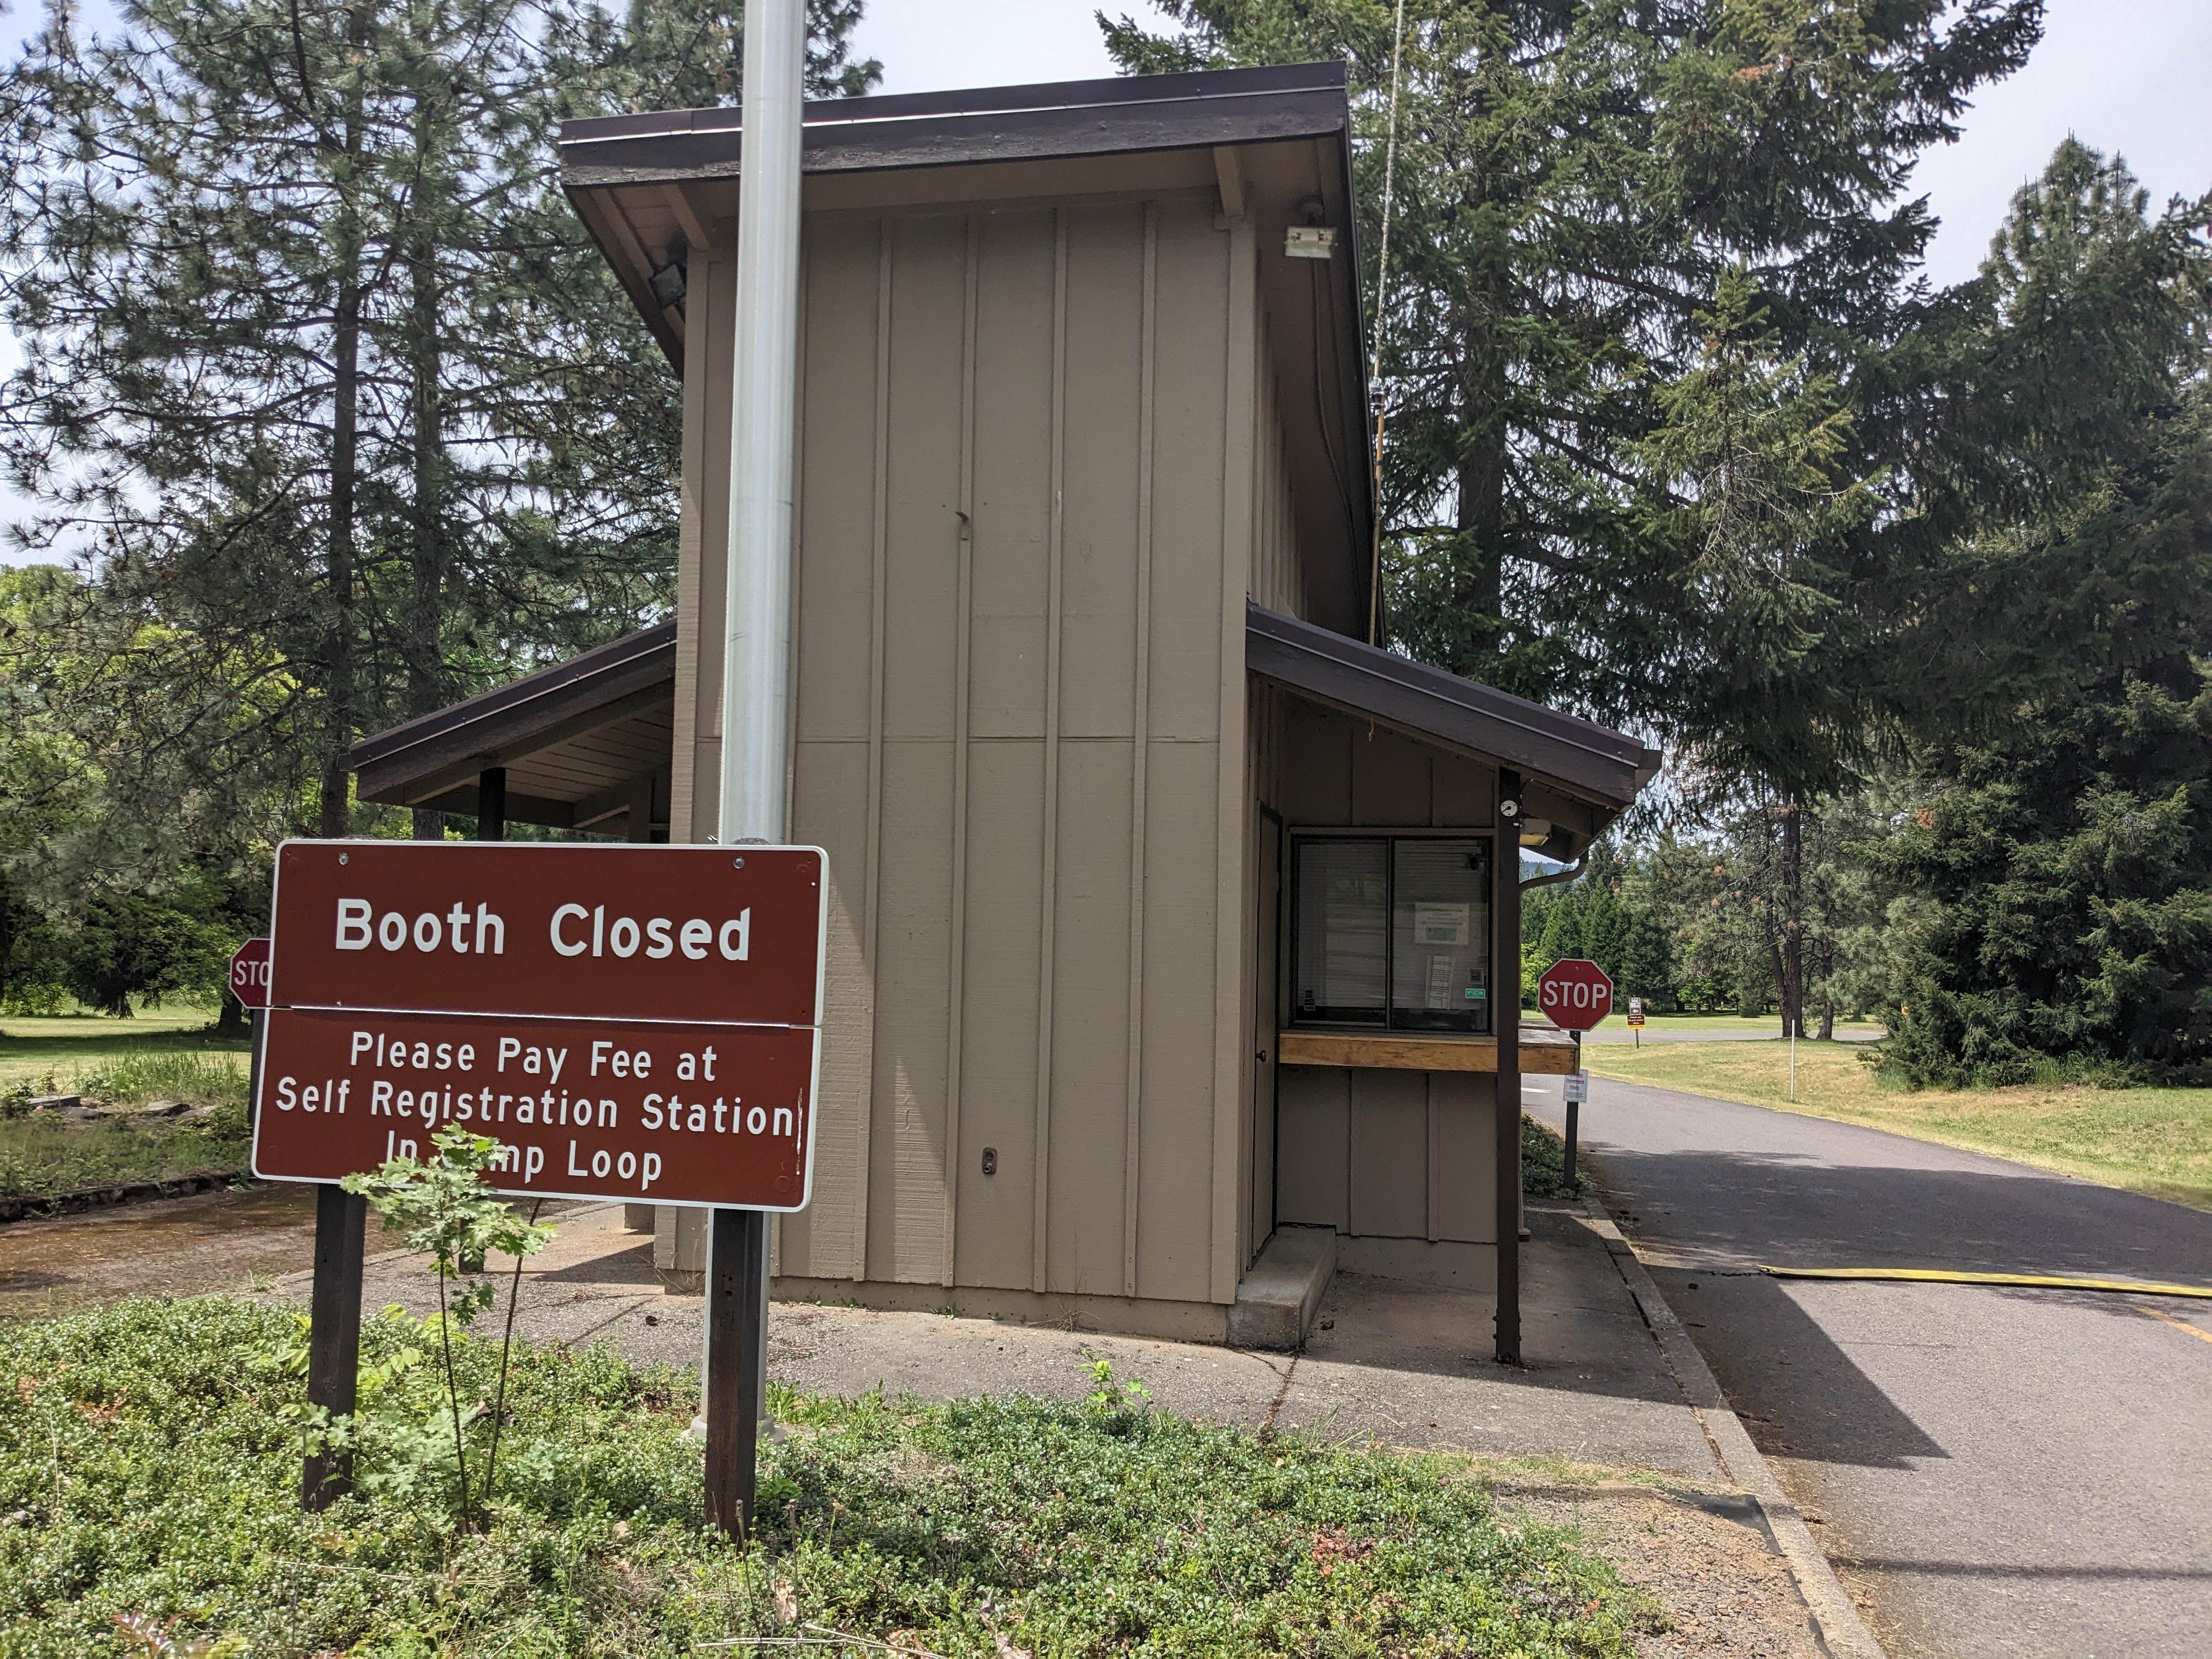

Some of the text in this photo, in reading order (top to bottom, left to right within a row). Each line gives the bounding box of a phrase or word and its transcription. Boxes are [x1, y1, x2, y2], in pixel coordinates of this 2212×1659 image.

[336, 899, 751, 961] Booth Closed
[234, 960, 269, 986] STO
[1543, 980, 1607, 1009] STOP
[351, 1031, 717, 1085] Please Pay Fee at
[276, 1076, 793, 1136] Self Registration Station
[387, 1130, 662, 1191] In mp Loop
